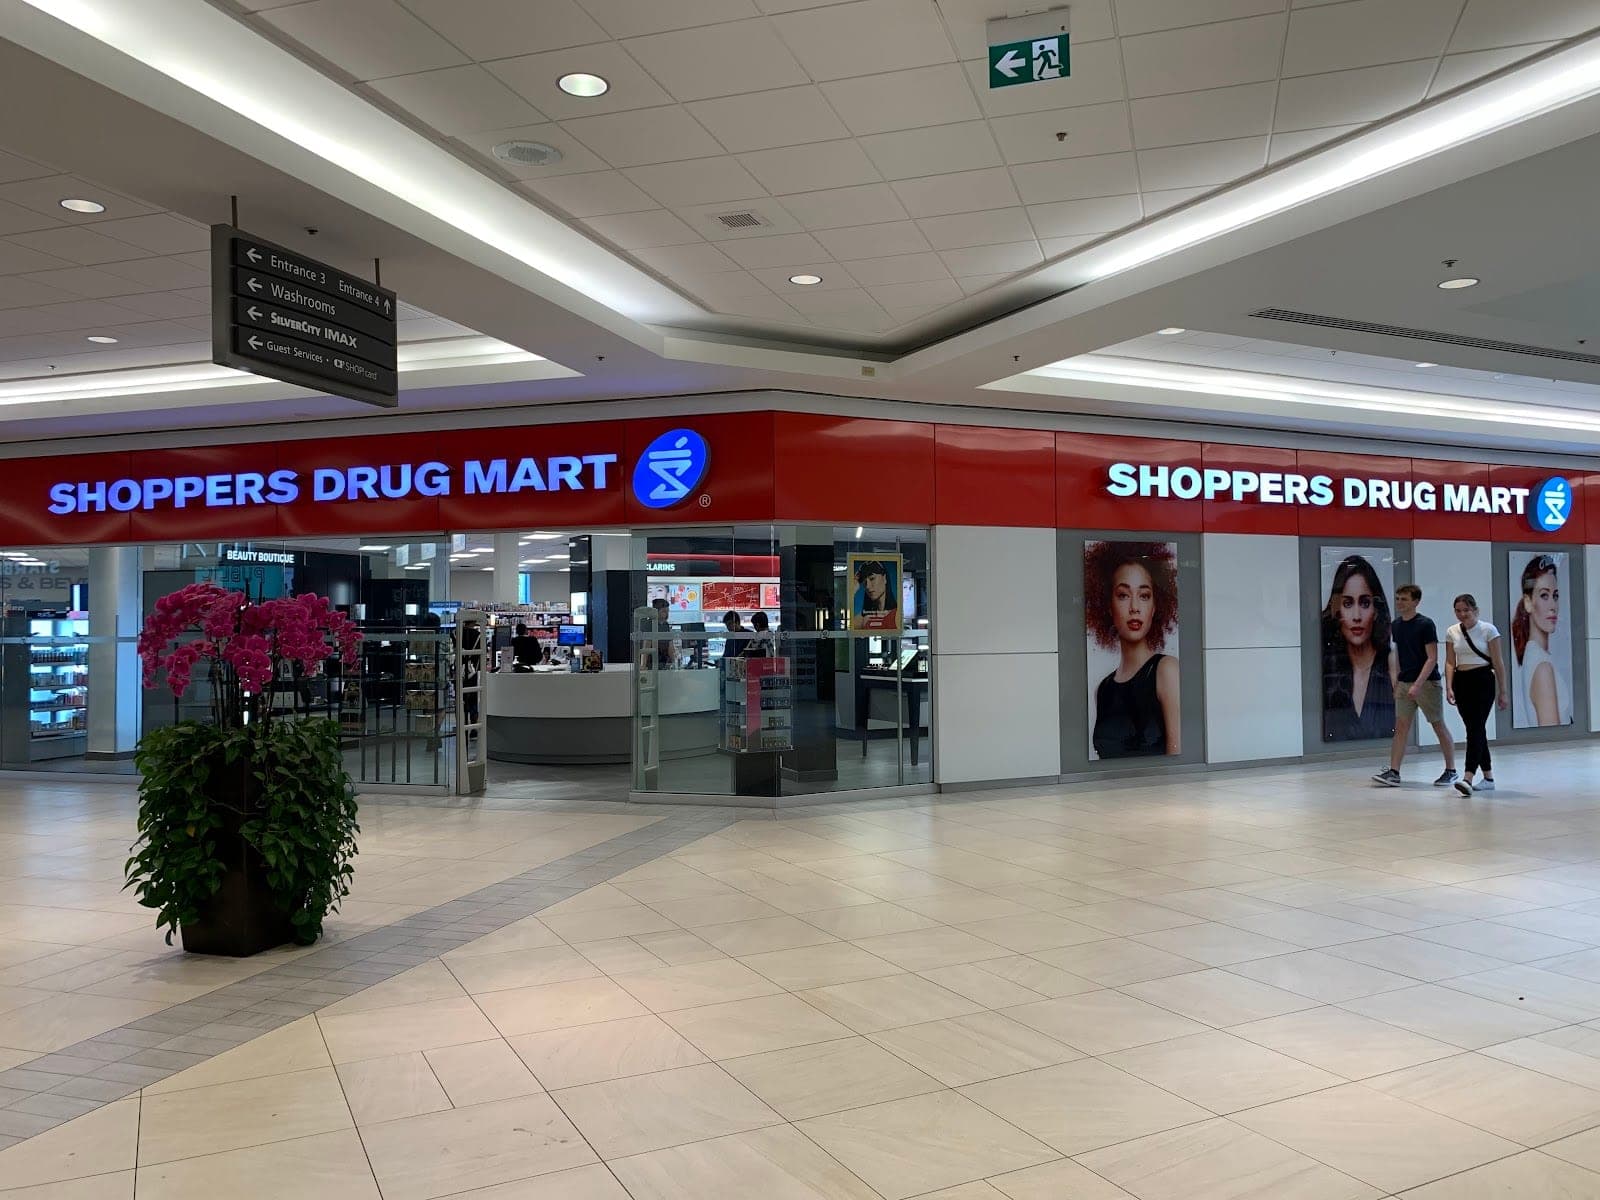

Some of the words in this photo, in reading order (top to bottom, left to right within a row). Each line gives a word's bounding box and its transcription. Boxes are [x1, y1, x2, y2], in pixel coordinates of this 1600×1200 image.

[271, 255, 317, 281] Entrance
[320, 273, 326, 284] 3
[271, 282, 336, 316] Washrooms
[339, 280, 373, 303] Entrance
[374, 296, 380, 306] 4
[267, 340, 291, 355] Guest
[293, 348, 323, 364] Services
[324, 328, 358, 349] IMAX
[48, 469, 299, 515] SHOPPERS
[313, 461, 450, 501] DRUG
[464, 453, 617, 494] MART
[1106, 463, 1334, 506] SHOPPERS
[1343, 477, 1436, 511] DRUG
[1443, 484, 1529, 515] MART
[226, 550, 258, 561] BEAUTY
[258, 552, 295, 563] BOUTIQUE
